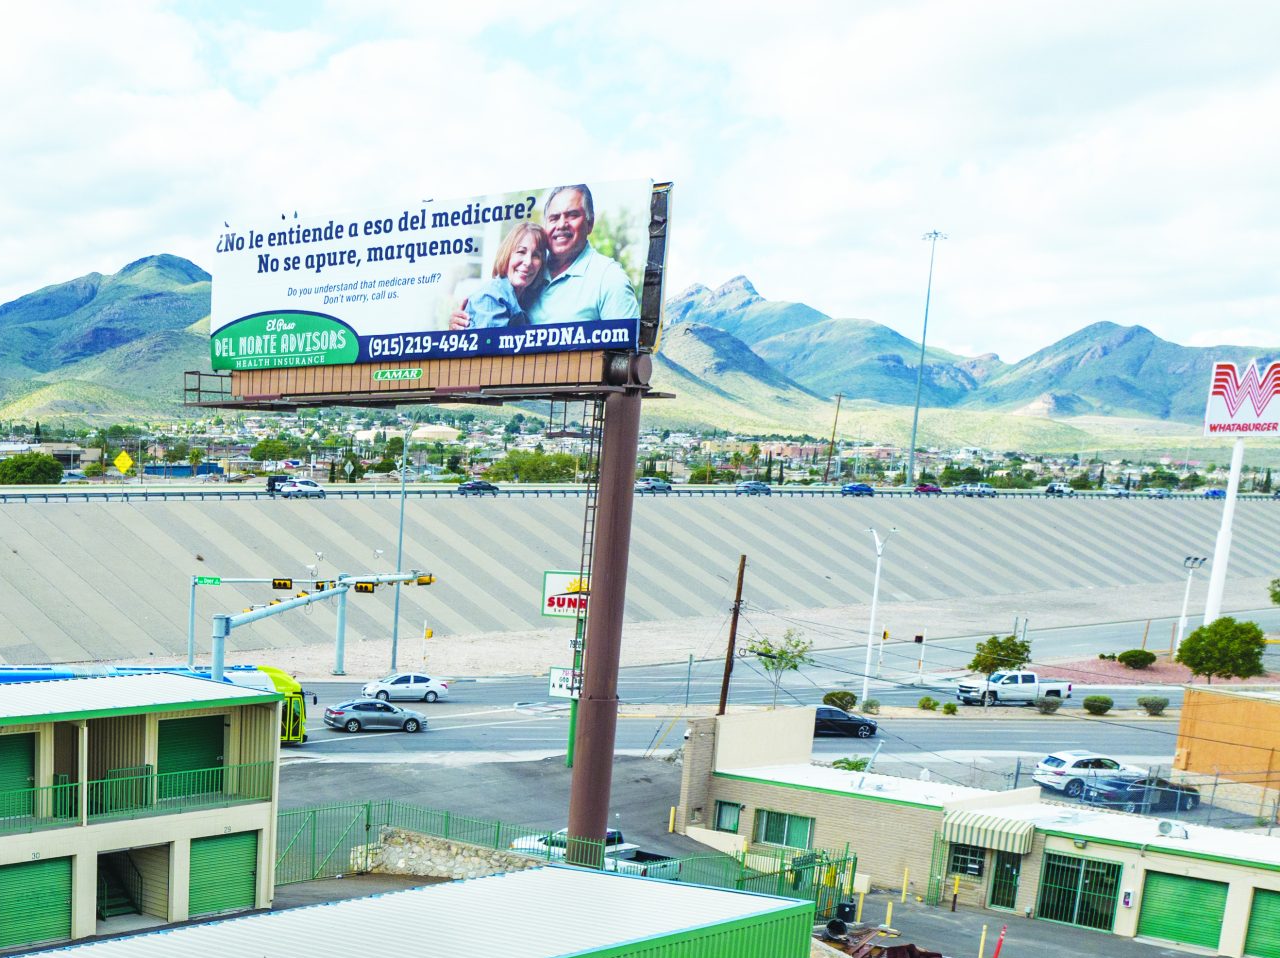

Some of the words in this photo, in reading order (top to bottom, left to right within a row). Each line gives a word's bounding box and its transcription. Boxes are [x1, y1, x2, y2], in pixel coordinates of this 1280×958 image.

[216, 233, 245, 253] ¿No
[248, 230, 264, 249] le
[268, 220, 344, 247] entiende
[348, 222, 359, 238] a
[363, 218, 393, 235] eso
[398, 208, 426, 232] del
[431, 196, 537, 229] medicare?
[257, 253, 280, 274] No
[283, 255, 301, 272] se
[305, 249, 362, 273] apure,
[367, 237, 479, 263] marquenos.
[287, 287, 298, 297] Do
[299, 287, 313, 298] you
[314, 280, 359, 295] understand
[360, 279, 376, 290] that
[378, 276, 416, 288] medicare
[417, 273, 442, 285] stuff?
[323, 295, 344, 305] Don't
[345, 293, 369, 303] worry,
[371, 290, 386, 301] call
[387, 291, 399, 299] us.
[266, 318, 275, 332] El
[276, 318, 296, 332] Paso
[214, 337, 236, 357] DEL
[239, 334, 277, 356] NORTE
[280, 329, 347, 353] ADVISORS
[498, 326, 630, 353] myEPDNA.com
[236, 358, 270, 368] HEALTH
[273, 355, 325, 366] INSURANCE
[377, 369, 418, 379] LAMAR
[1209, 422, 1279, 433] WHATABURGER
